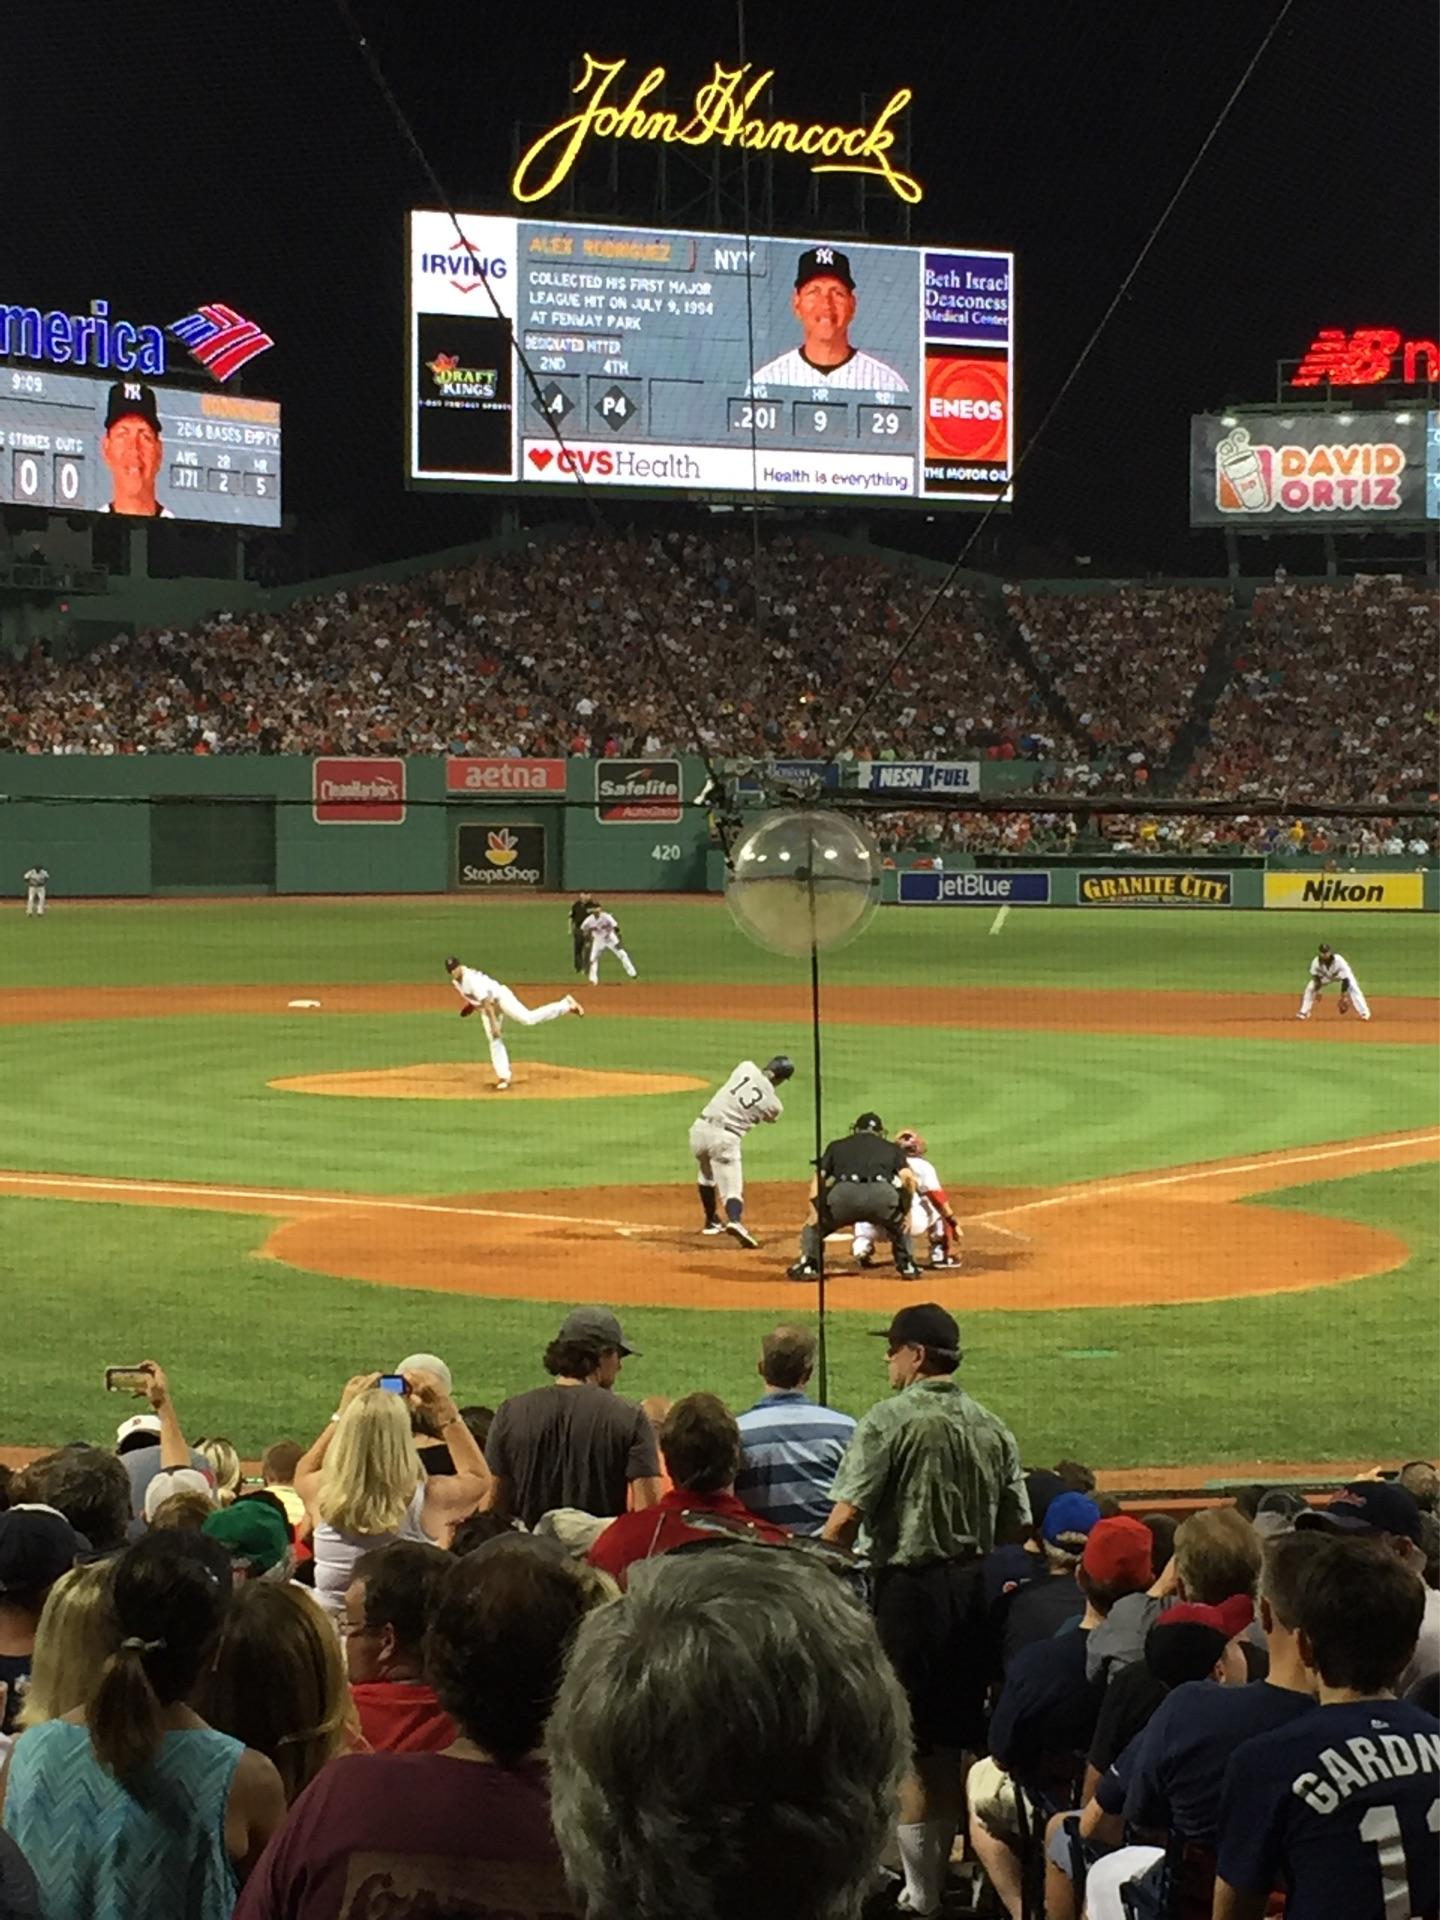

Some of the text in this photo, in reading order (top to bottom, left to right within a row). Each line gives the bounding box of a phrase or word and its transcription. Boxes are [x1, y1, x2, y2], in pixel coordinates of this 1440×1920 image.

[512, 52, 922, 203] John Hancock
[421, 252, 508, 280] IRVING
[714, 248, 756, 271] NYY
[529, 271, 713, 297] COLLECTED HIS FIRST MAJOR
[925, 268, 1008, 292] Beth Israel
[528, 291, 714, 317] LEAGUE HIT ON JULY 9, 1994
[925, 288, 1008, 311] Deaconess
[530, 311, 642, 331] AT FENWAY PARK
[925, 308, 970, 324] Medical
[524, 336, 622, 355] DESIGNATED HITTER
[439, 370, 496, 384] DRAFT
[540, 356, 630, 375] 2ND 4TH
[11, 372, 43, 392] 9:09
[442, 382, 496, 398] KINGS
[744, 384, 768, 399] AVG
[602, 397, 627, 417] P4
[929, 397, 1004, 421] ENEOS
[733, 407, 899, 434] .201 9 29
[175, 450, 199, 466] AVG
[1281, 447, 1401, 477] DAVID
[20, 458, 78, 499] 0 0
[219, 473, 229, 492] 2
[256, 477, 267, 496] 5
[764, 467, 909, 491] Health is everything
[925, 467, 945, 479] THE
[946, 468, 988, 481] MOTOR
[1281, 479, 1399, 509] ORTIZ
[465, 764, 547, 788] aetna
[879, 767, 970, 787] NESN FUEL
[600, 780, 679, 796] Safelite
[651, 845, 681, 860] 420
[463, 864, 541, 884] Stop&Shop
[936, 872, 1012, 900] jetBlue
[1083, 874, 1228, 900] GRANITE CITY
[1302, 880, 1384, 902] Nikon
[730, 1076, 763, 1109] 13
